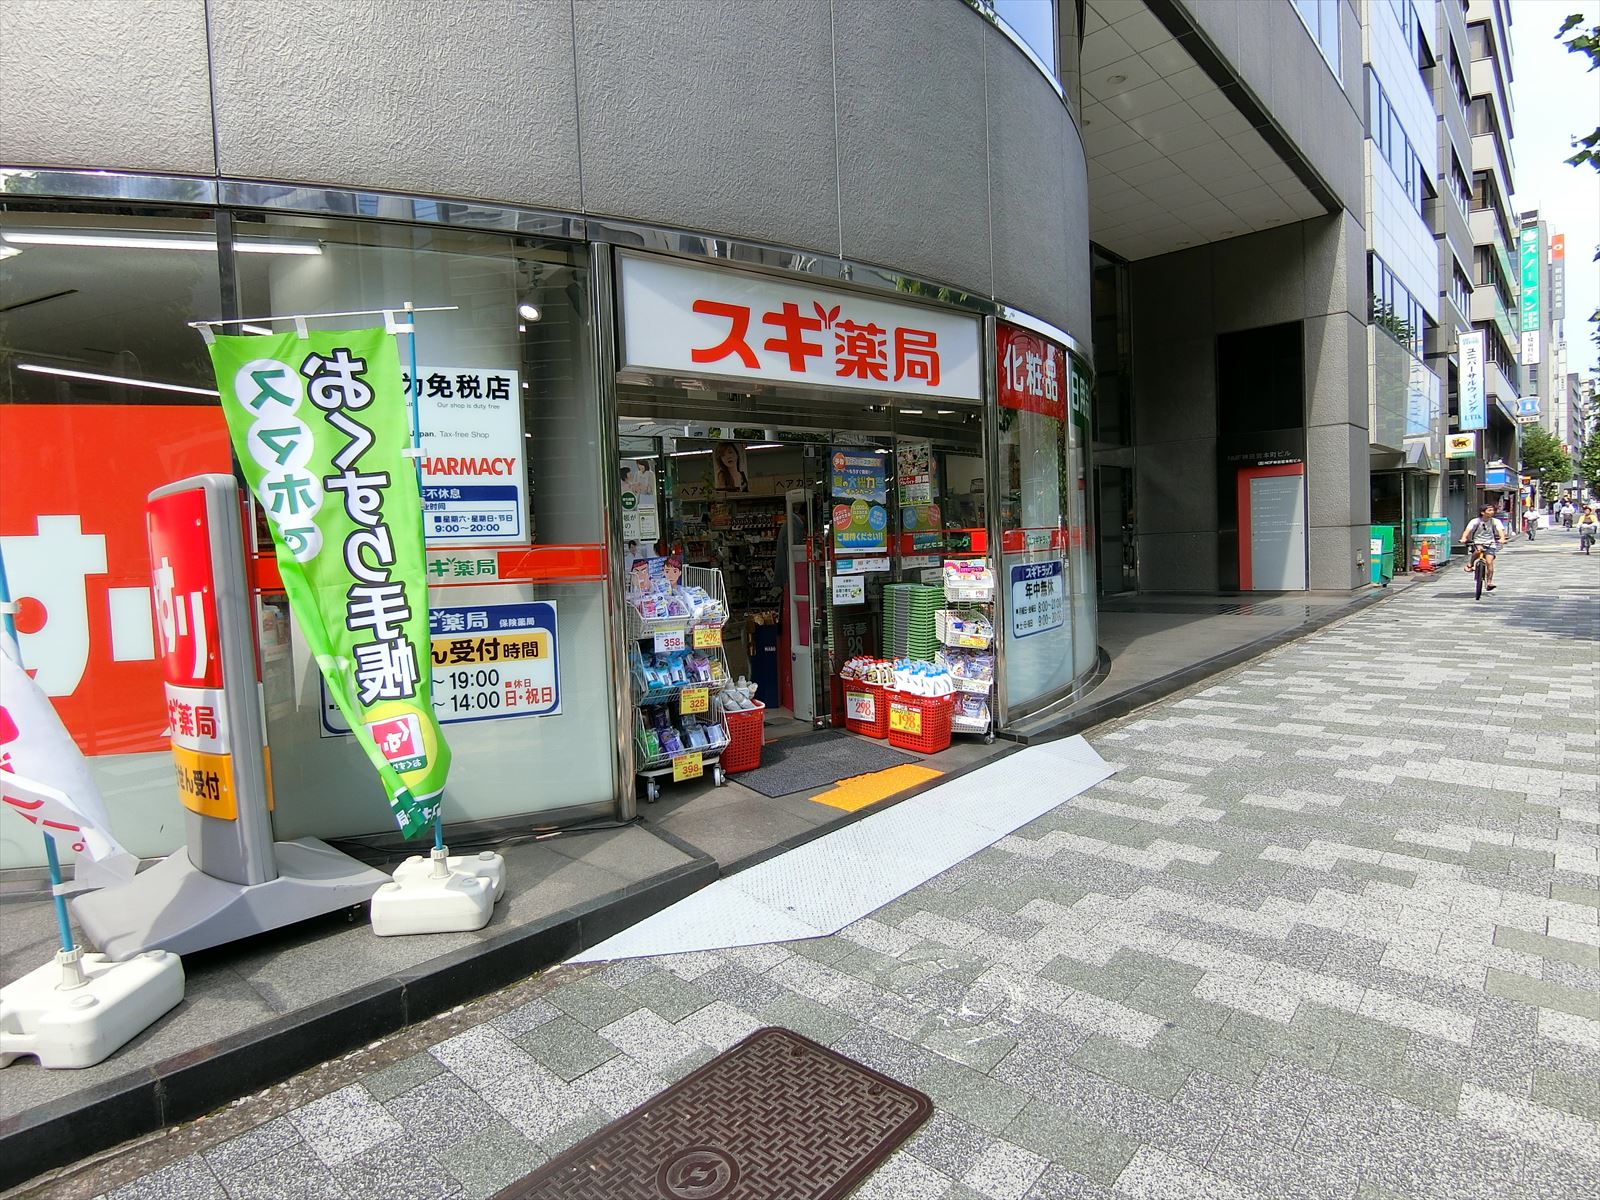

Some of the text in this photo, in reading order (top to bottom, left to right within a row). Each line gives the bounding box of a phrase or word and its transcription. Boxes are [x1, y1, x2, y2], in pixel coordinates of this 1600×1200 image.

[691, 299, 940, 387] スギ薬局
[1003, 343, 1058, 402] 化粧品
[402, 373, 511, 401] 为免税店
[410, 430, 436, 438] Jpan.
[471, 431, 489, 439] Shop
[413, 457, 516, 476] HARMACY
[1025, 563, 1054, 578] スギドラッグ
[1025, 579, 1055, 600] 年中無休
[664, 638, 680, 647] 358
[513, 678, 532, 689] 休日
[690, 699, 705, 708] 328
[856, 702, 872, 716] 298
[898, 714, 916, 729] 198
[682, 764, 699, 775] 398
